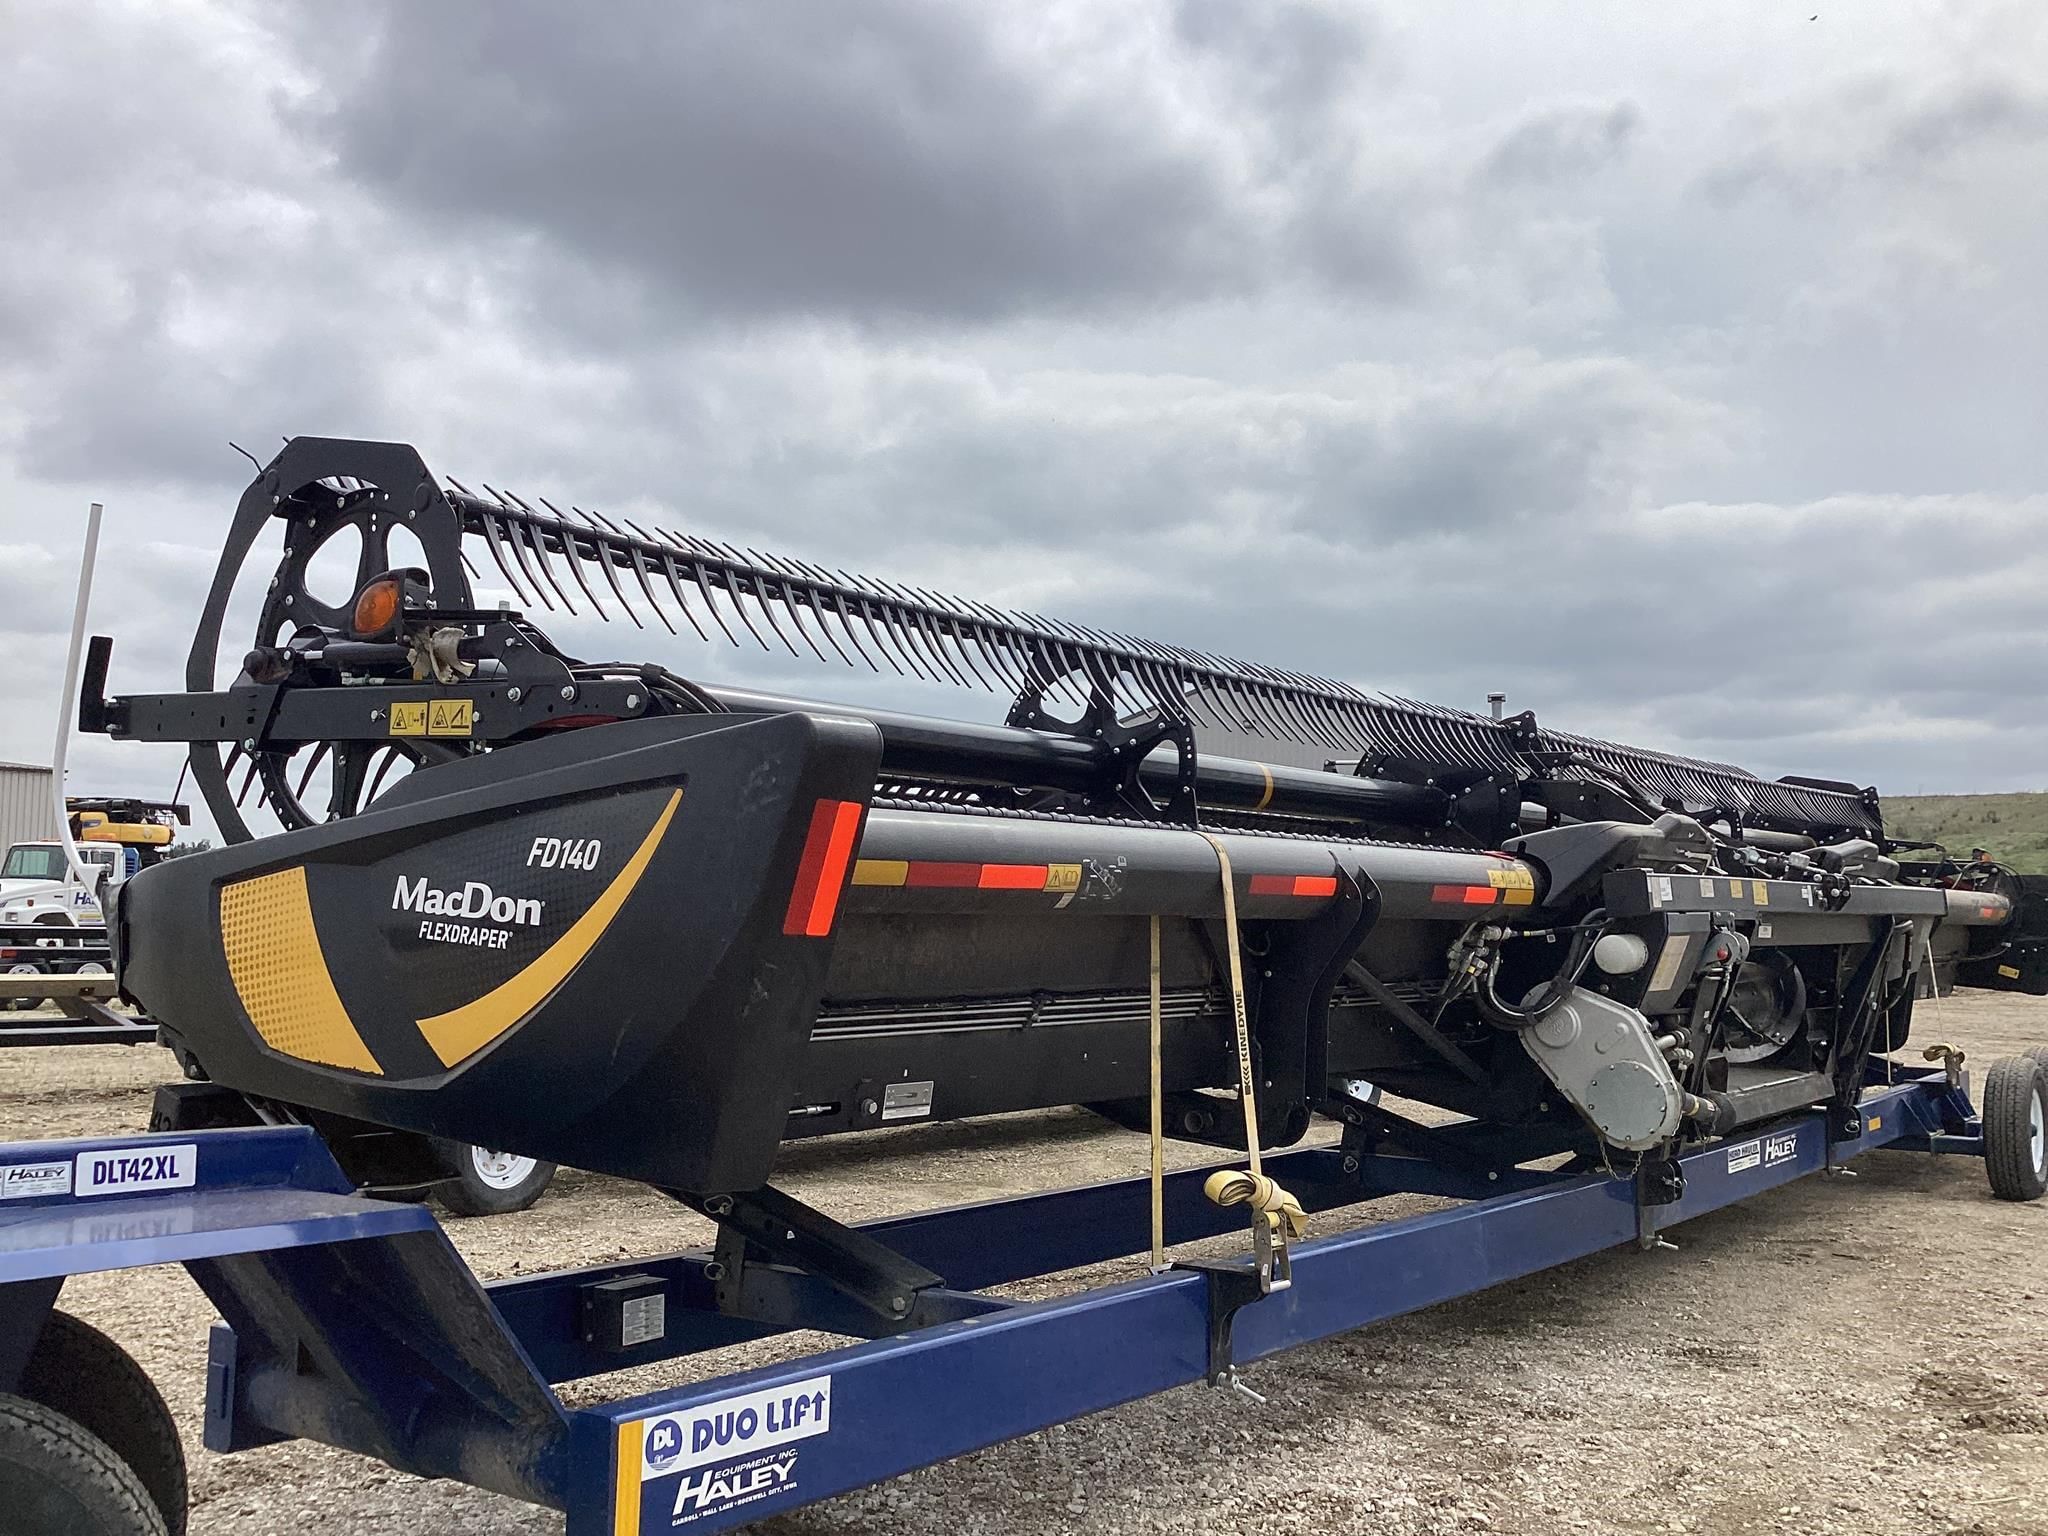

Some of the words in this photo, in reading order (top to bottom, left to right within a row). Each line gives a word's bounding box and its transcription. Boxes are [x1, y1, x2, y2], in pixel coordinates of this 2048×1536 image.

[526, 837, 601, 871] FD140
[391, 875, 542, 926] MacDon
[418, 921, 509, 949] FLEXDRAPER
[1235, 989, 1248, 1061] KINEDYNE
[1765, 1137, 1797, 1162] HALEY
[8, 1168, 65, 1181] HALEY
[93, 1155, 179, 1186] DLT42XL
[692, 1407, 758, 1454] DUO
[714, 1454, 776, 1480] EQUIPMENT
[778, 1448, 799, 1459] INC.
[672, 1457, 798, 1516] HALEY
[672, 1511, 699, 1527] CARROLL
[783, 1481, 798, 1491] IOWA
